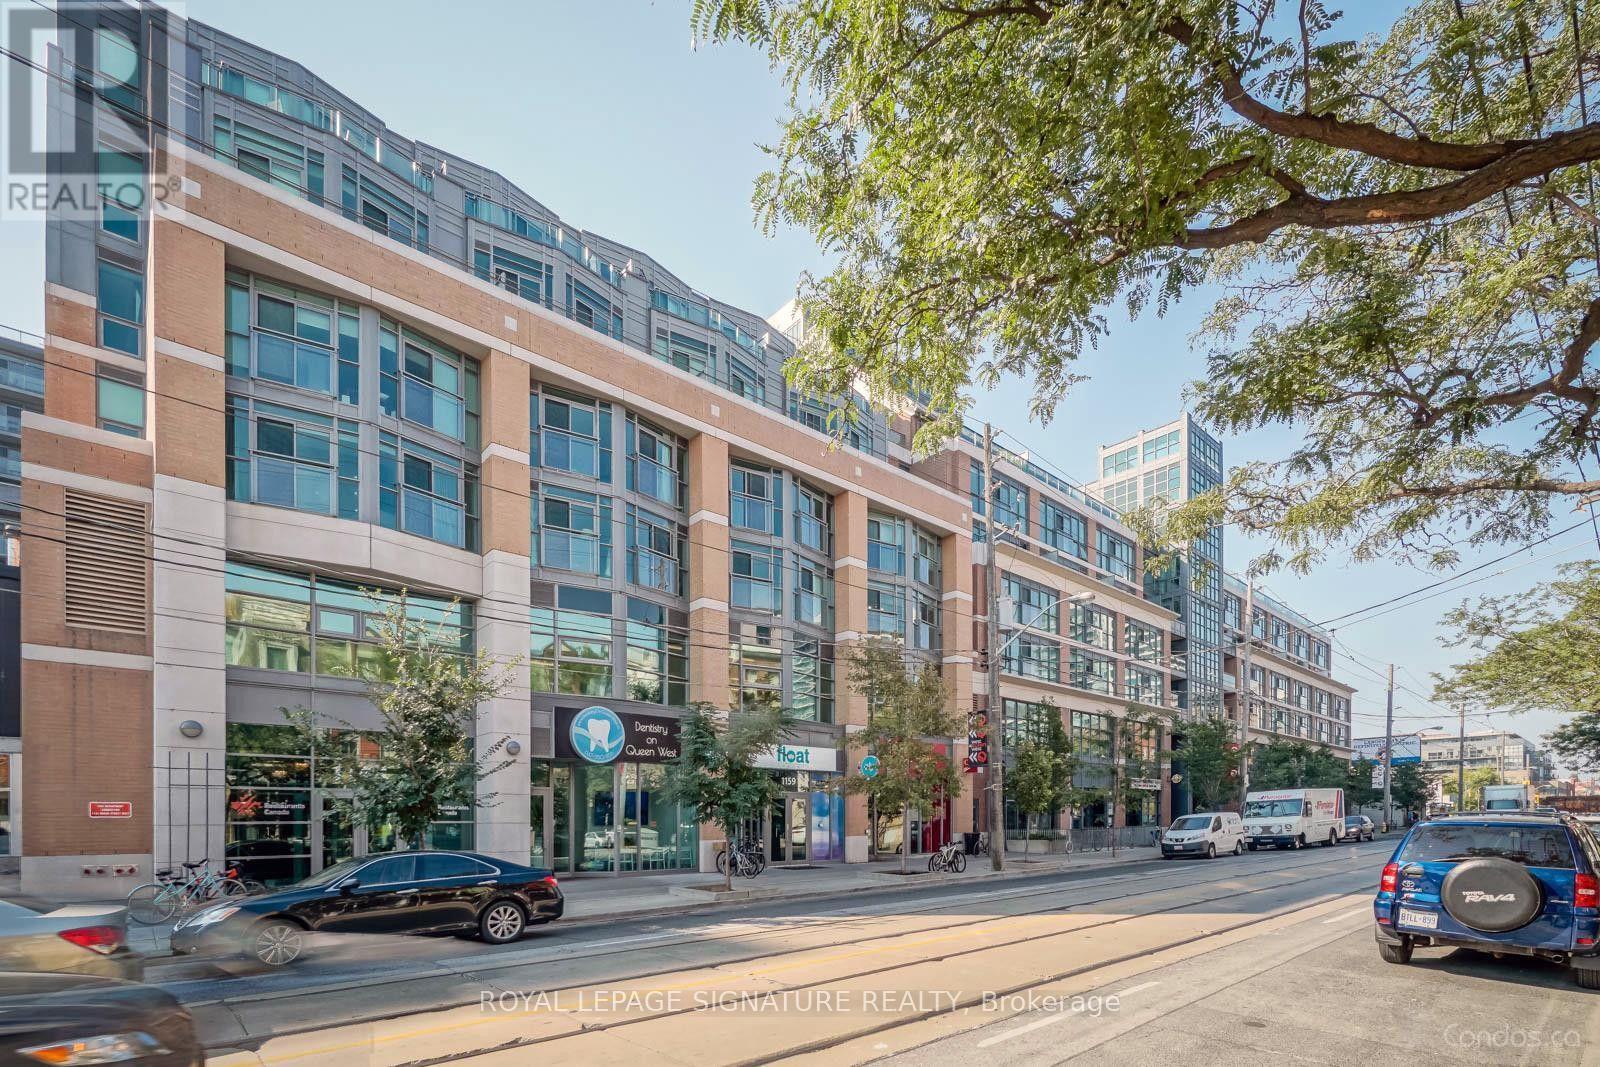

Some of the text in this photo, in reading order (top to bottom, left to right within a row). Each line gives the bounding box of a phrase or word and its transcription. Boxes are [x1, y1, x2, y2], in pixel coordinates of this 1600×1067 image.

[635, 721, 668, 735] Dentistry
[625, 744, 655, 756] Queen
[657, 747, 677, 757] West
[777, 744, 810, 764] float
[781, 777, 796, 785] 1159
[1464, 893, 1516, 903] RAV4
